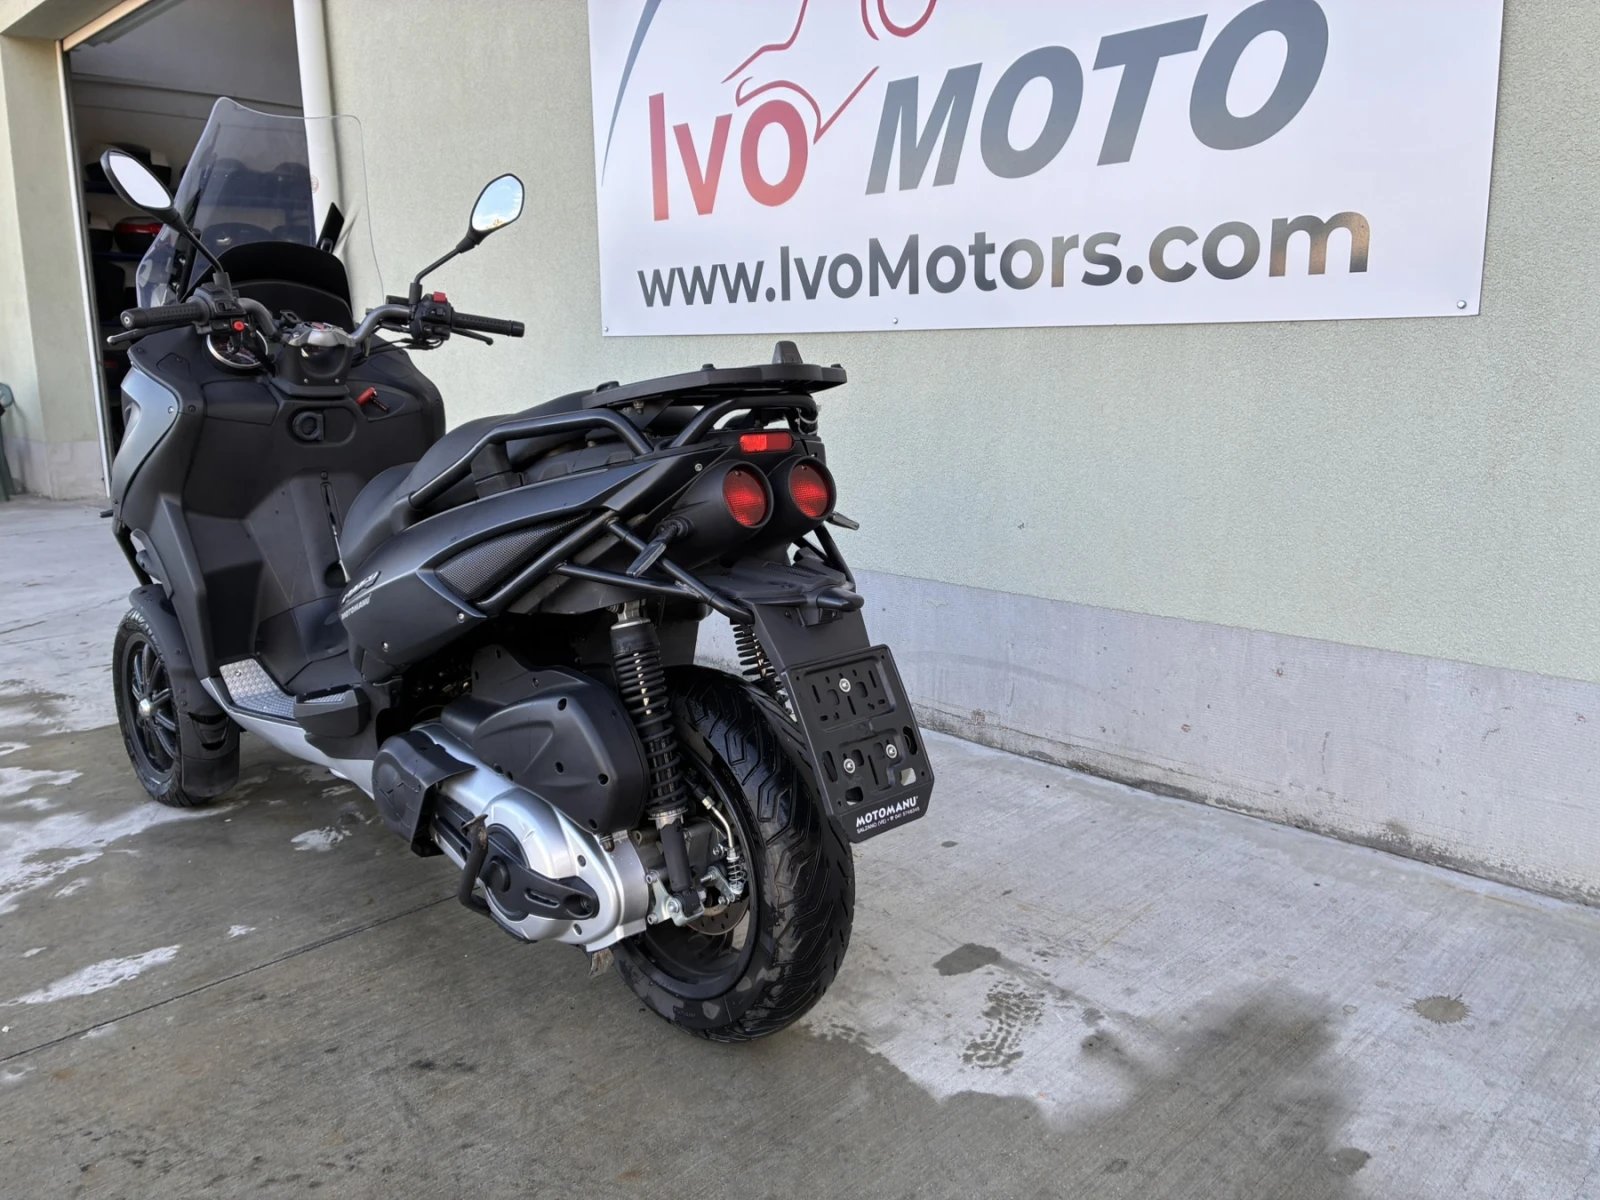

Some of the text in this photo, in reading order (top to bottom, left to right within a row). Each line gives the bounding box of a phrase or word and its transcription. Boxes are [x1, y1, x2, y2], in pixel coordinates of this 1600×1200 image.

[866, 0, 1329, 194] MOTO
[638, 212, 1371, 308] www.IvoMotors.com
[856, 796, 917, 827] MOTOMANU
